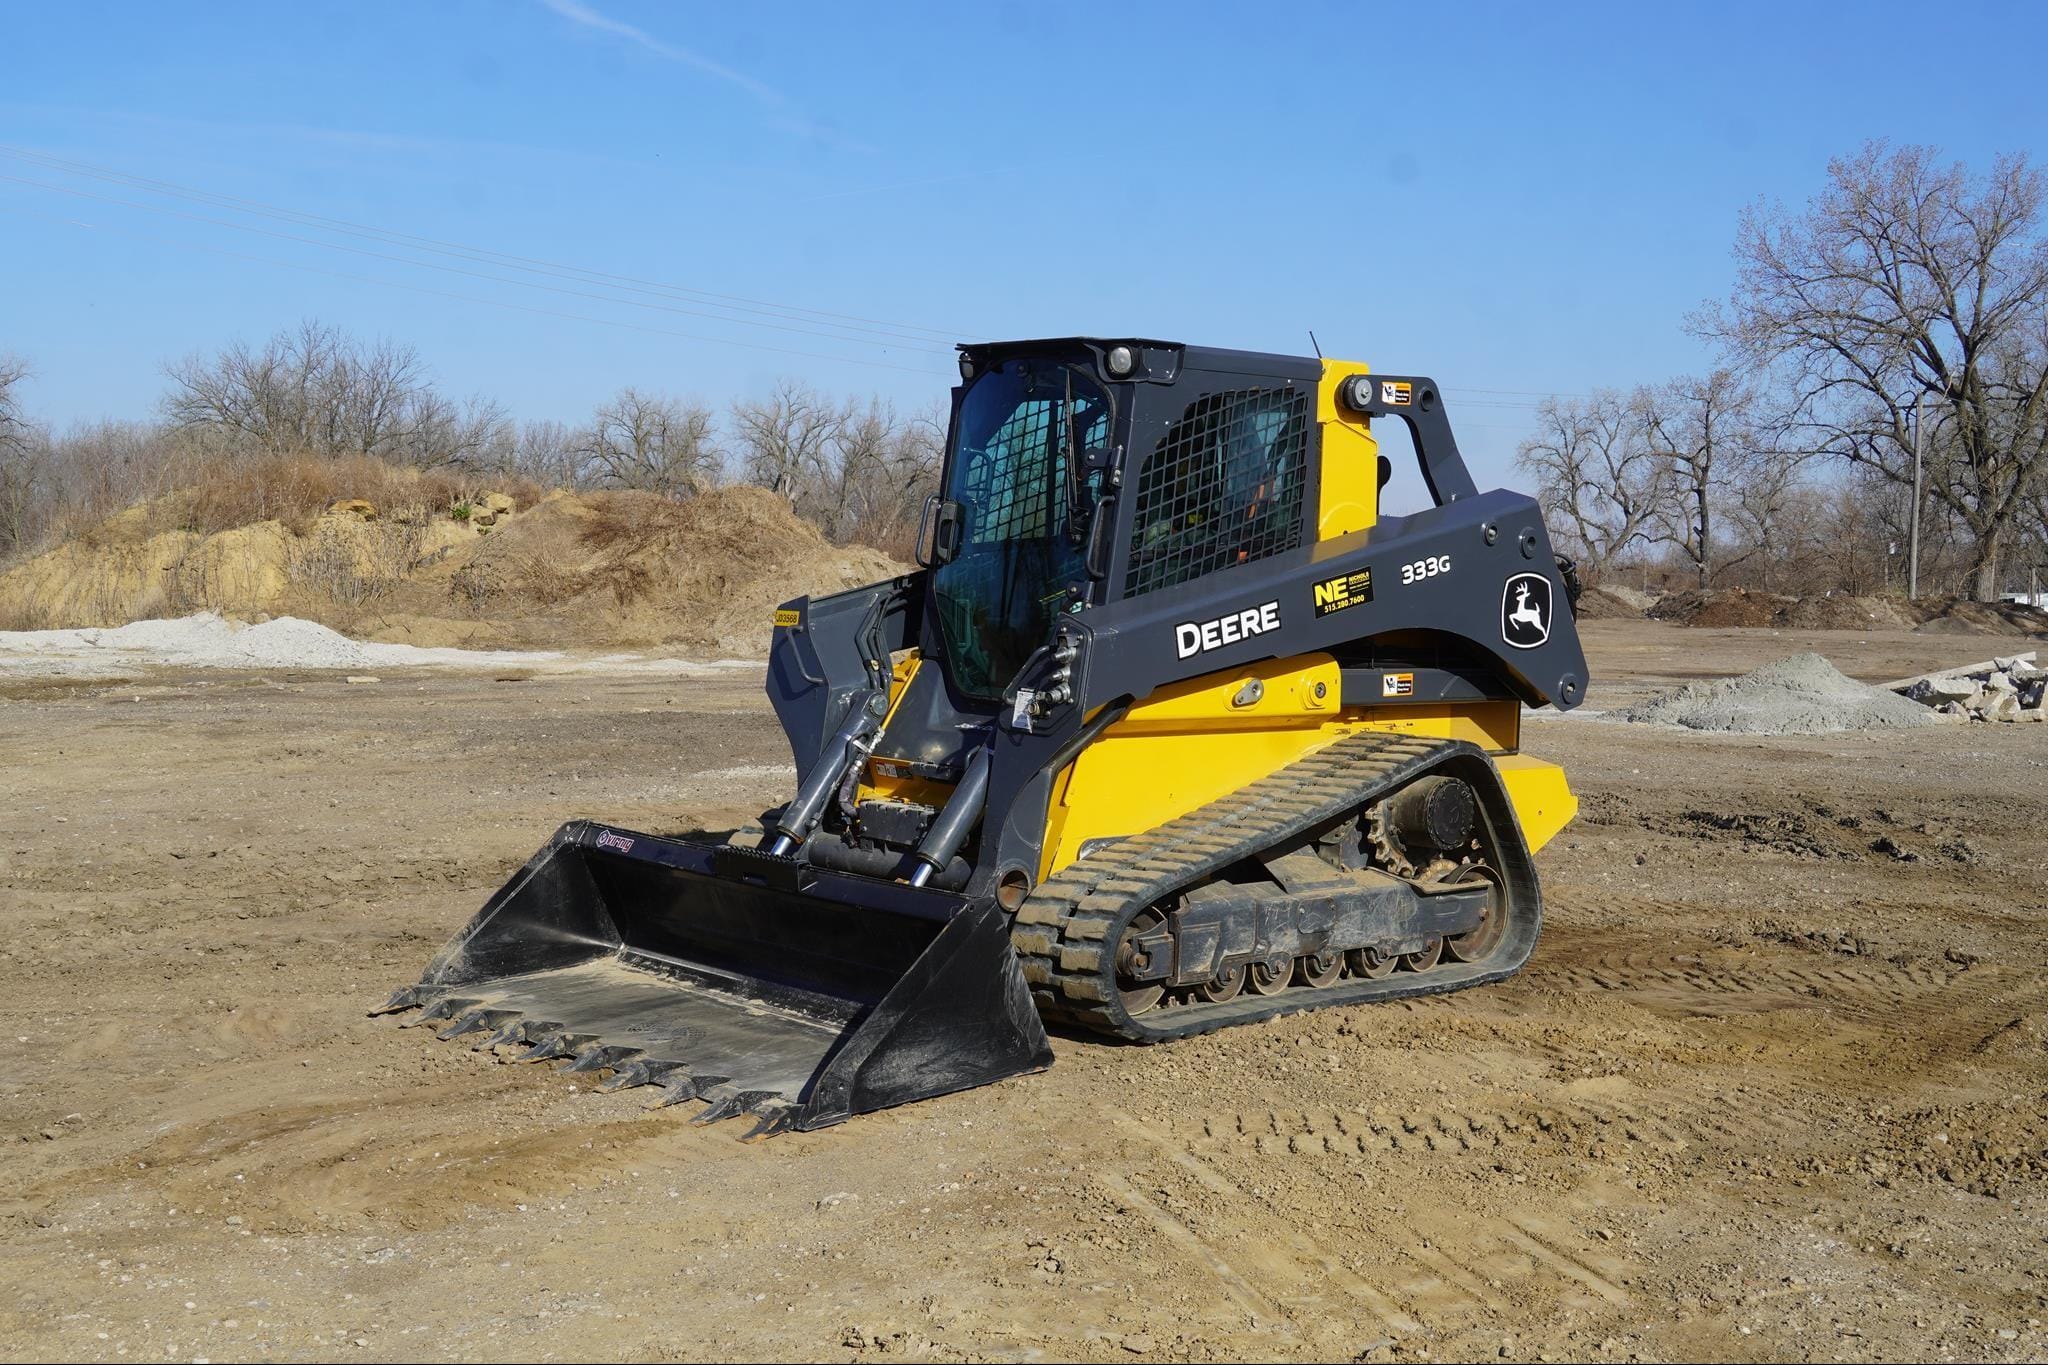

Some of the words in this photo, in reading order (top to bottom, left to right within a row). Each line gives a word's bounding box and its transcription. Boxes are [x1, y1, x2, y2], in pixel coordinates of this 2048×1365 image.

[1401, 555, 1451, 585] 333G
[1314, 577, 1349, 607] NE
[1175, 601, 1280, 659] DEERE
